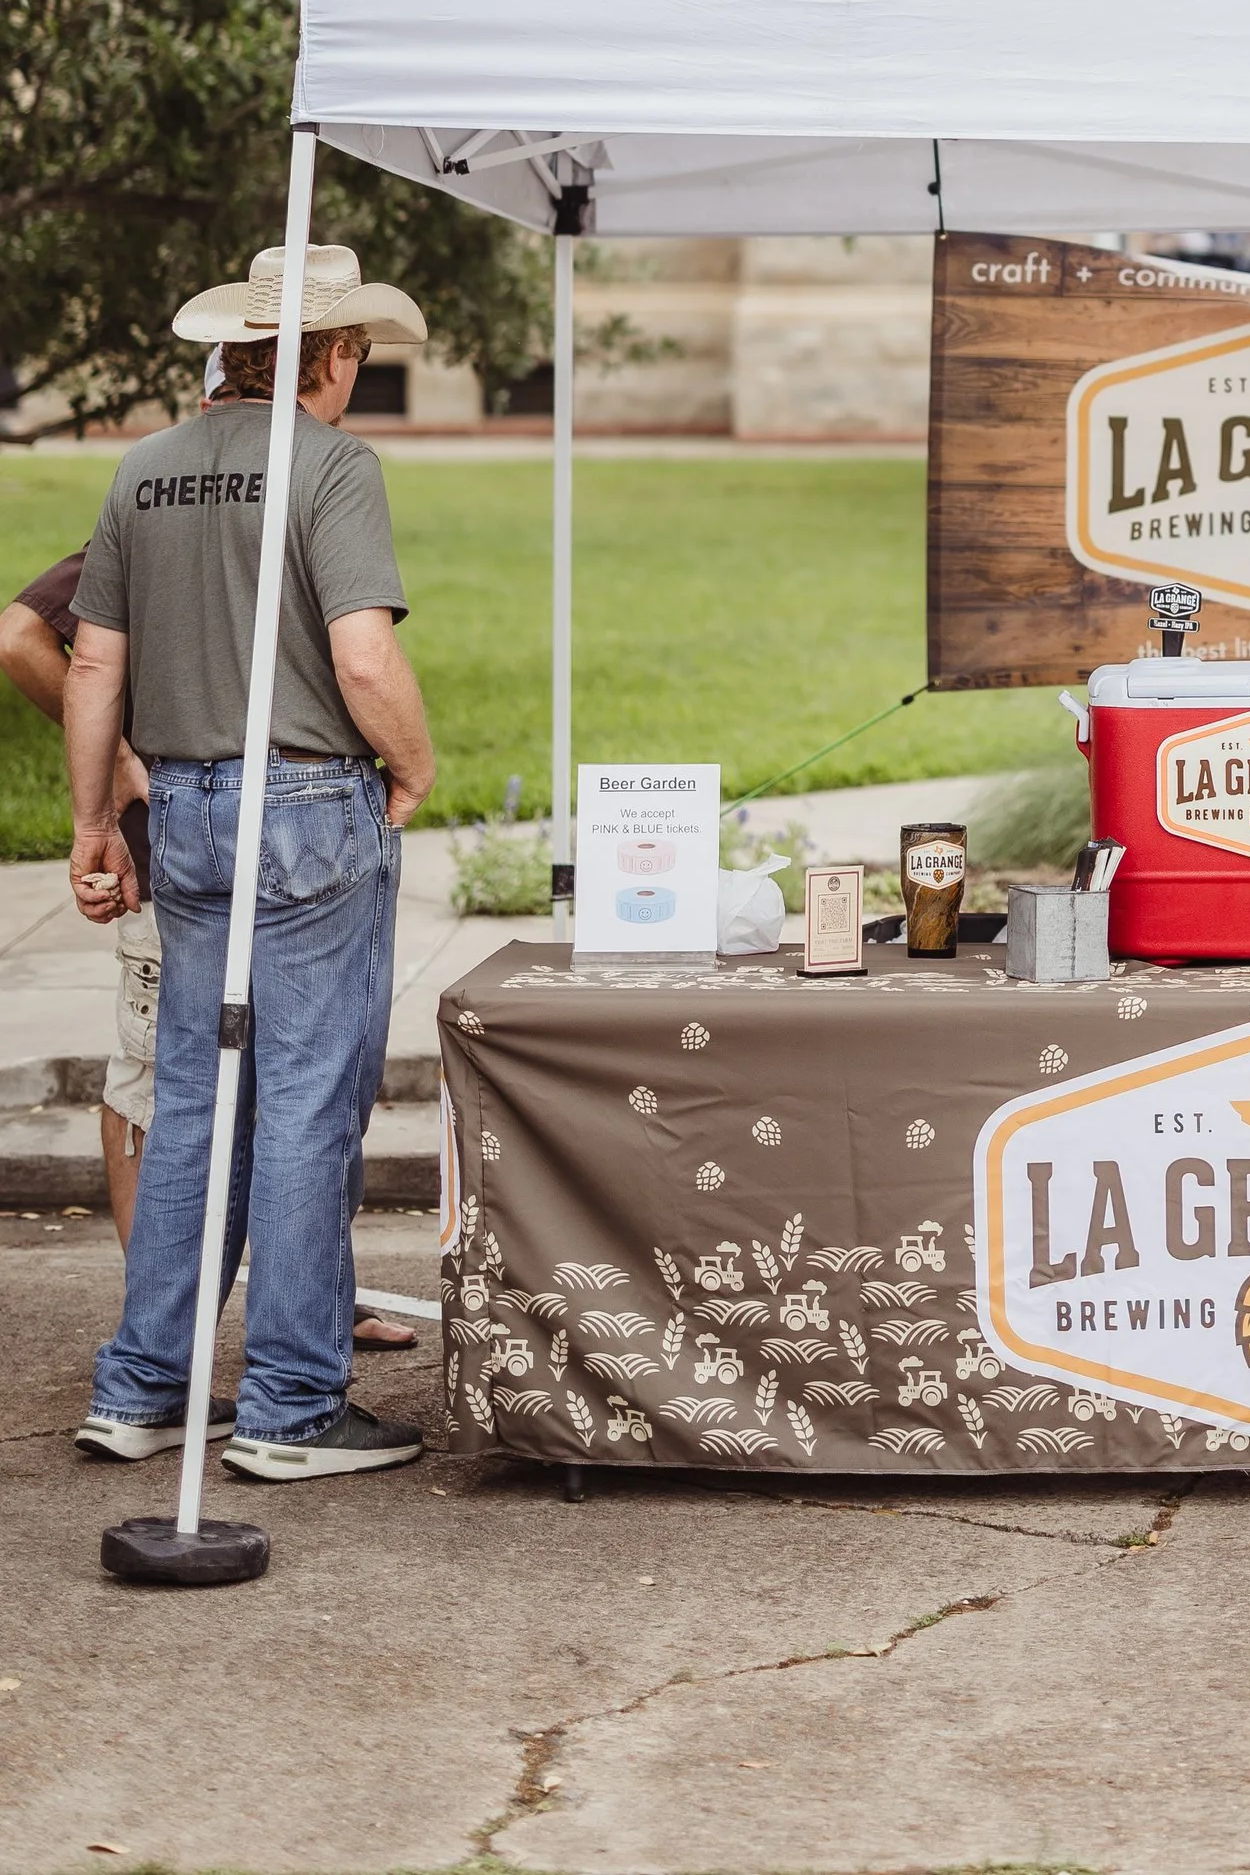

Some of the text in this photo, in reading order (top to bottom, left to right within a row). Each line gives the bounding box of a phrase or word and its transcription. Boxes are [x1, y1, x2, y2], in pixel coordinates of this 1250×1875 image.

[971, 251, 1051, 284] craft
[1108, 415, 1197, 515] LA
[1154, 592, 1197, 607] LA GRANGE
[1221, 742, 1244, 751] EST.
[599, 777, 696, 790] Beer Garden
[1176, 759, 1217, 805] LA
[620, 809, 675, 820] We accept
[1185, 808, 1244, 821] BREWING
[592, 824, 702, 834] PINK & BLUE tickets.
[911, 855, 963, 870] LA GRANGE
[1154, 1112, 1213, 1134] EST.
[1027, 1159, 1140, 1290] LA
[1056, 1297, 1217, 1332] BREWING
